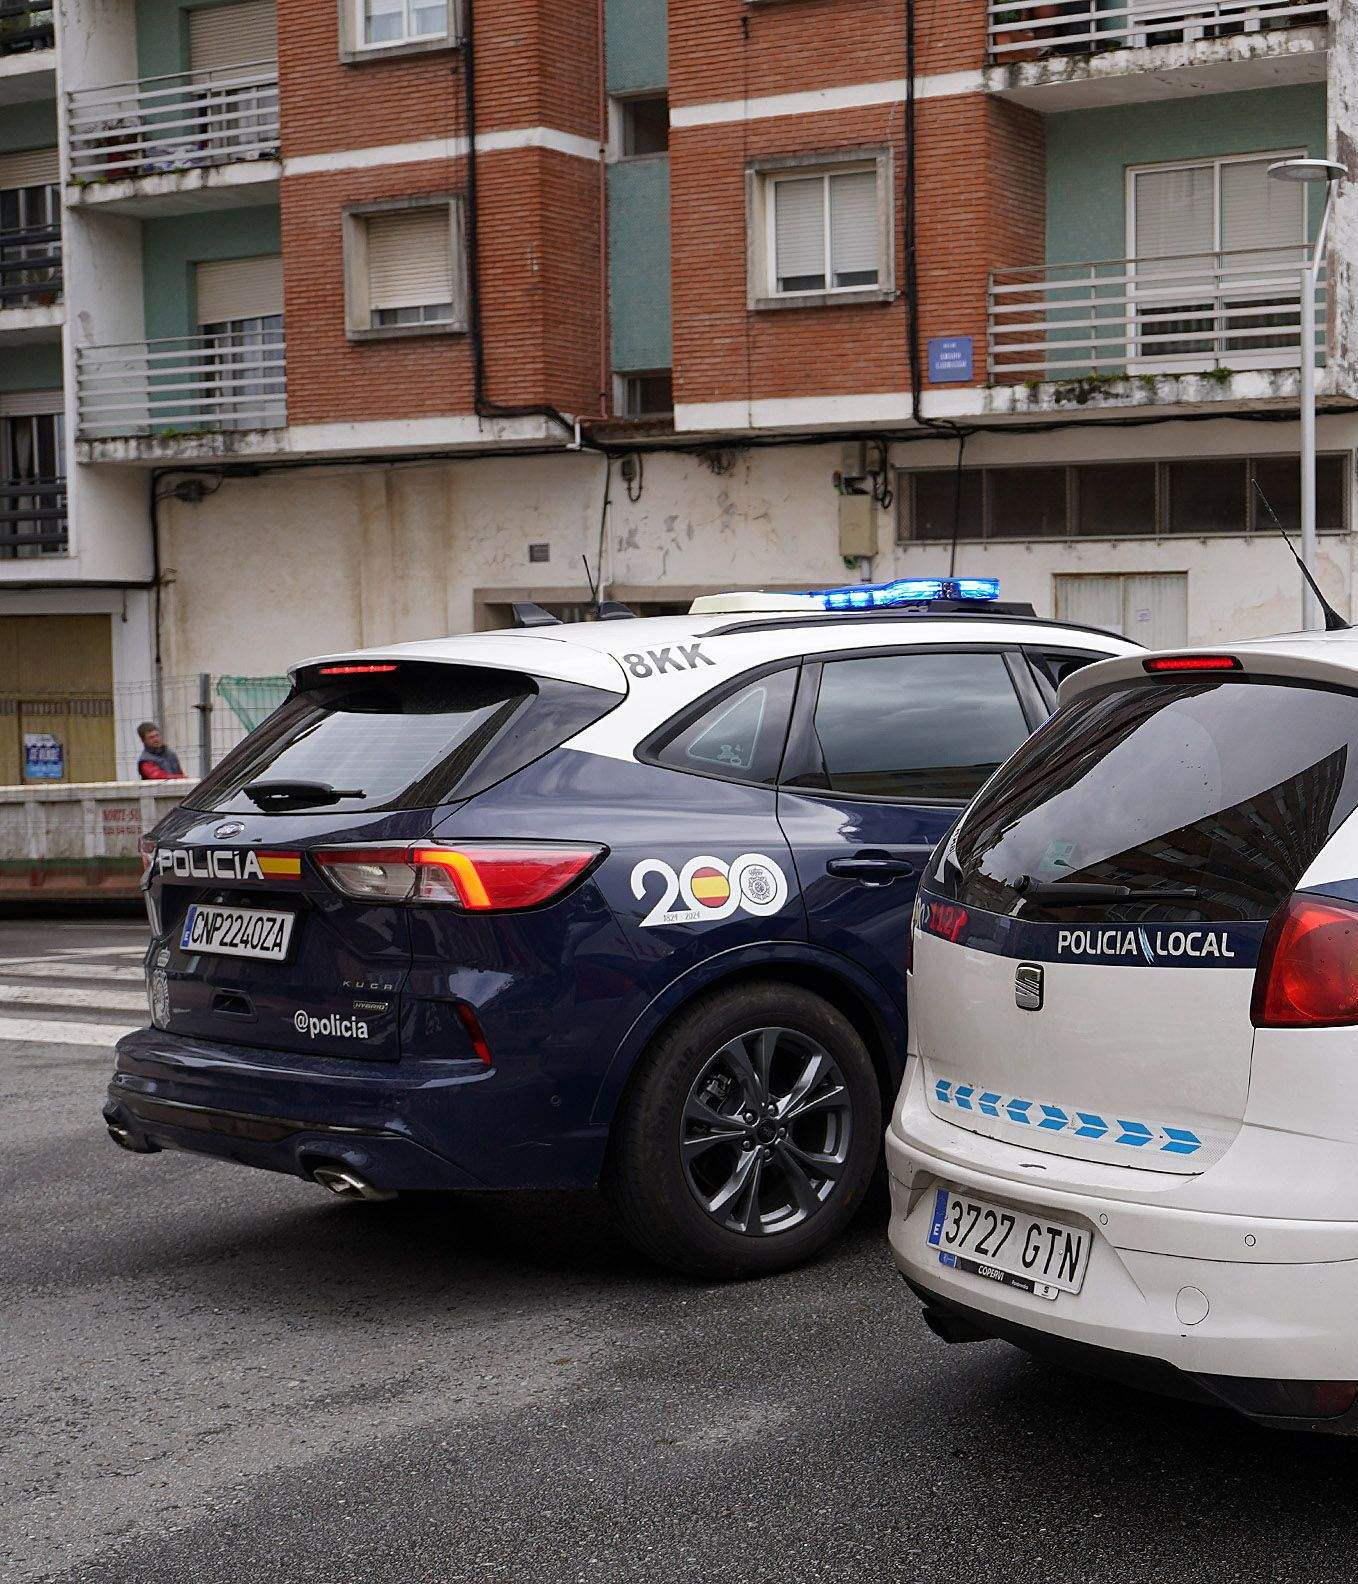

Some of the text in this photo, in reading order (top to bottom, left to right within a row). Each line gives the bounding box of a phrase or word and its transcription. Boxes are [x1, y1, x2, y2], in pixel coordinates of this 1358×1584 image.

[622, 643, 716, 678] 8KK
[630, 853, 788, 927] 200
[191, 910, 285, 953] CNP2240ZA
[1057, 930, 1235, 958] POLICIA LOCAL
[294, 1009, 369, 1039] @policia
[933, 1200, 1082, 1282] E 3727 GTN
